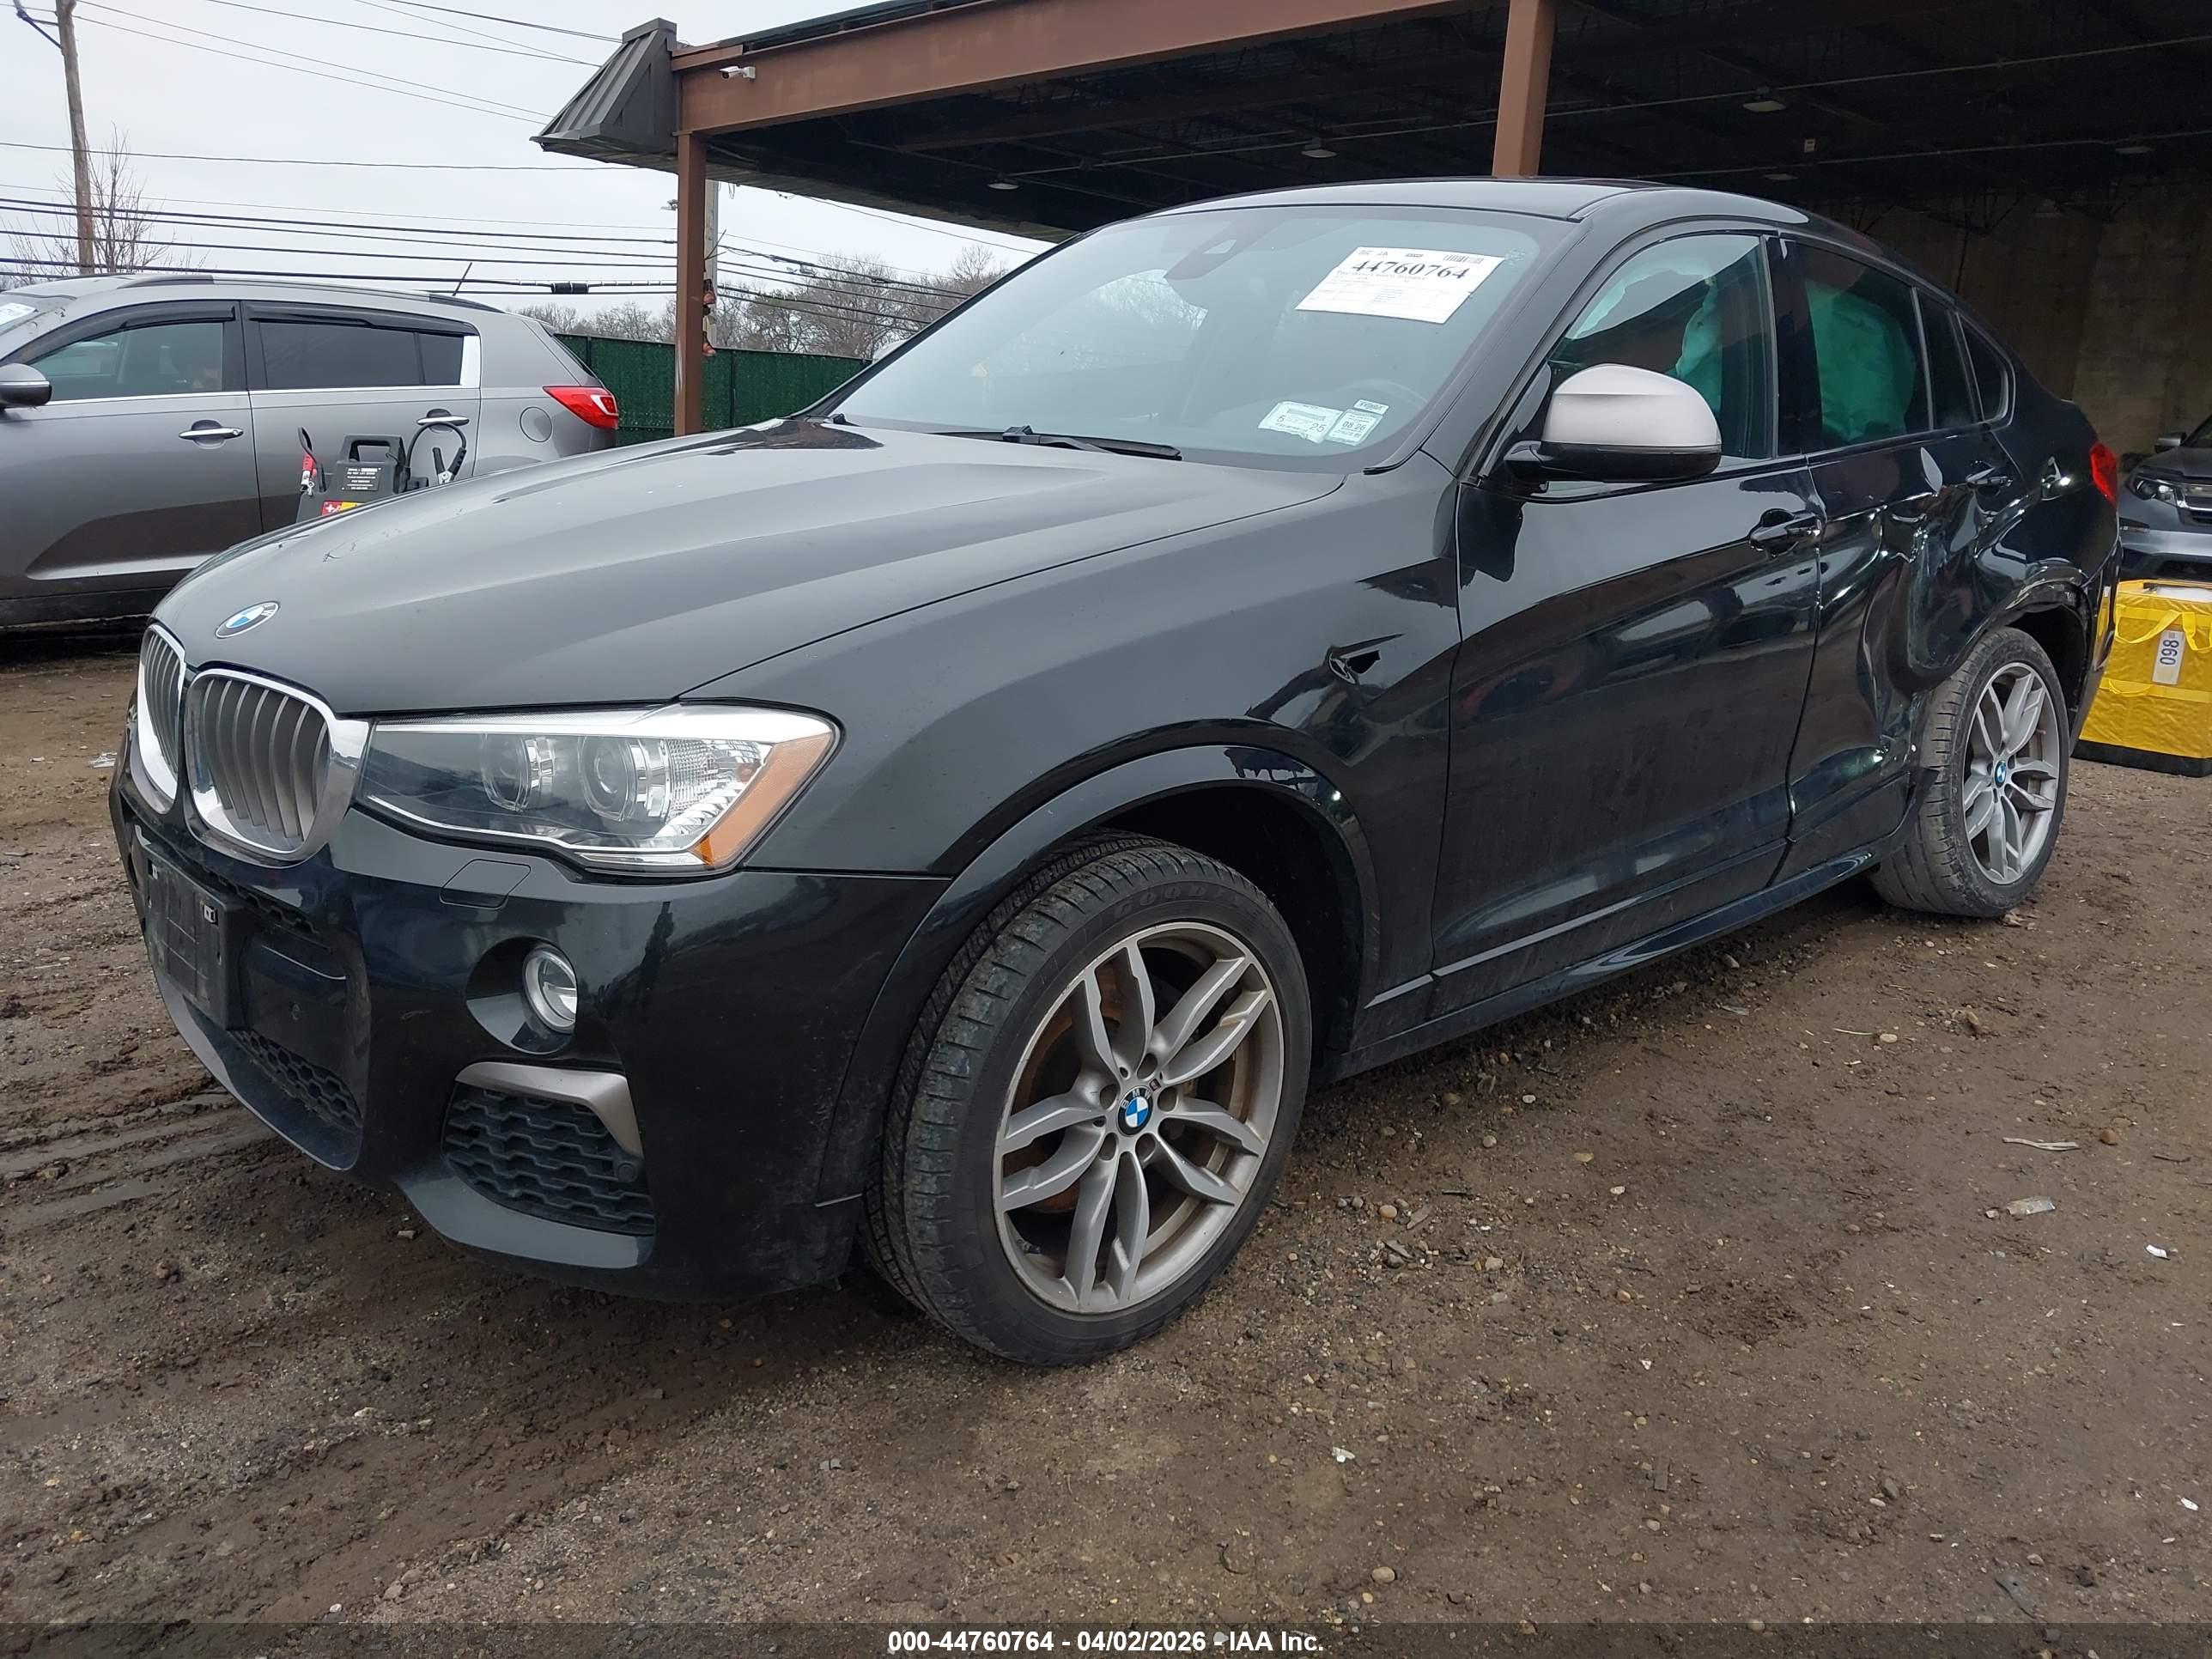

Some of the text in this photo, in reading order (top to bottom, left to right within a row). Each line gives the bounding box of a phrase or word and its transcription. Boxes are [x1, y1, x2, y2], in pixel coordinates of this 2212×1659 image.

[1352, 260, 1471, 279] 44760764
[1310, 422, 1327, 433] 25
[1121, 1087, 1152, 1109] BMW
